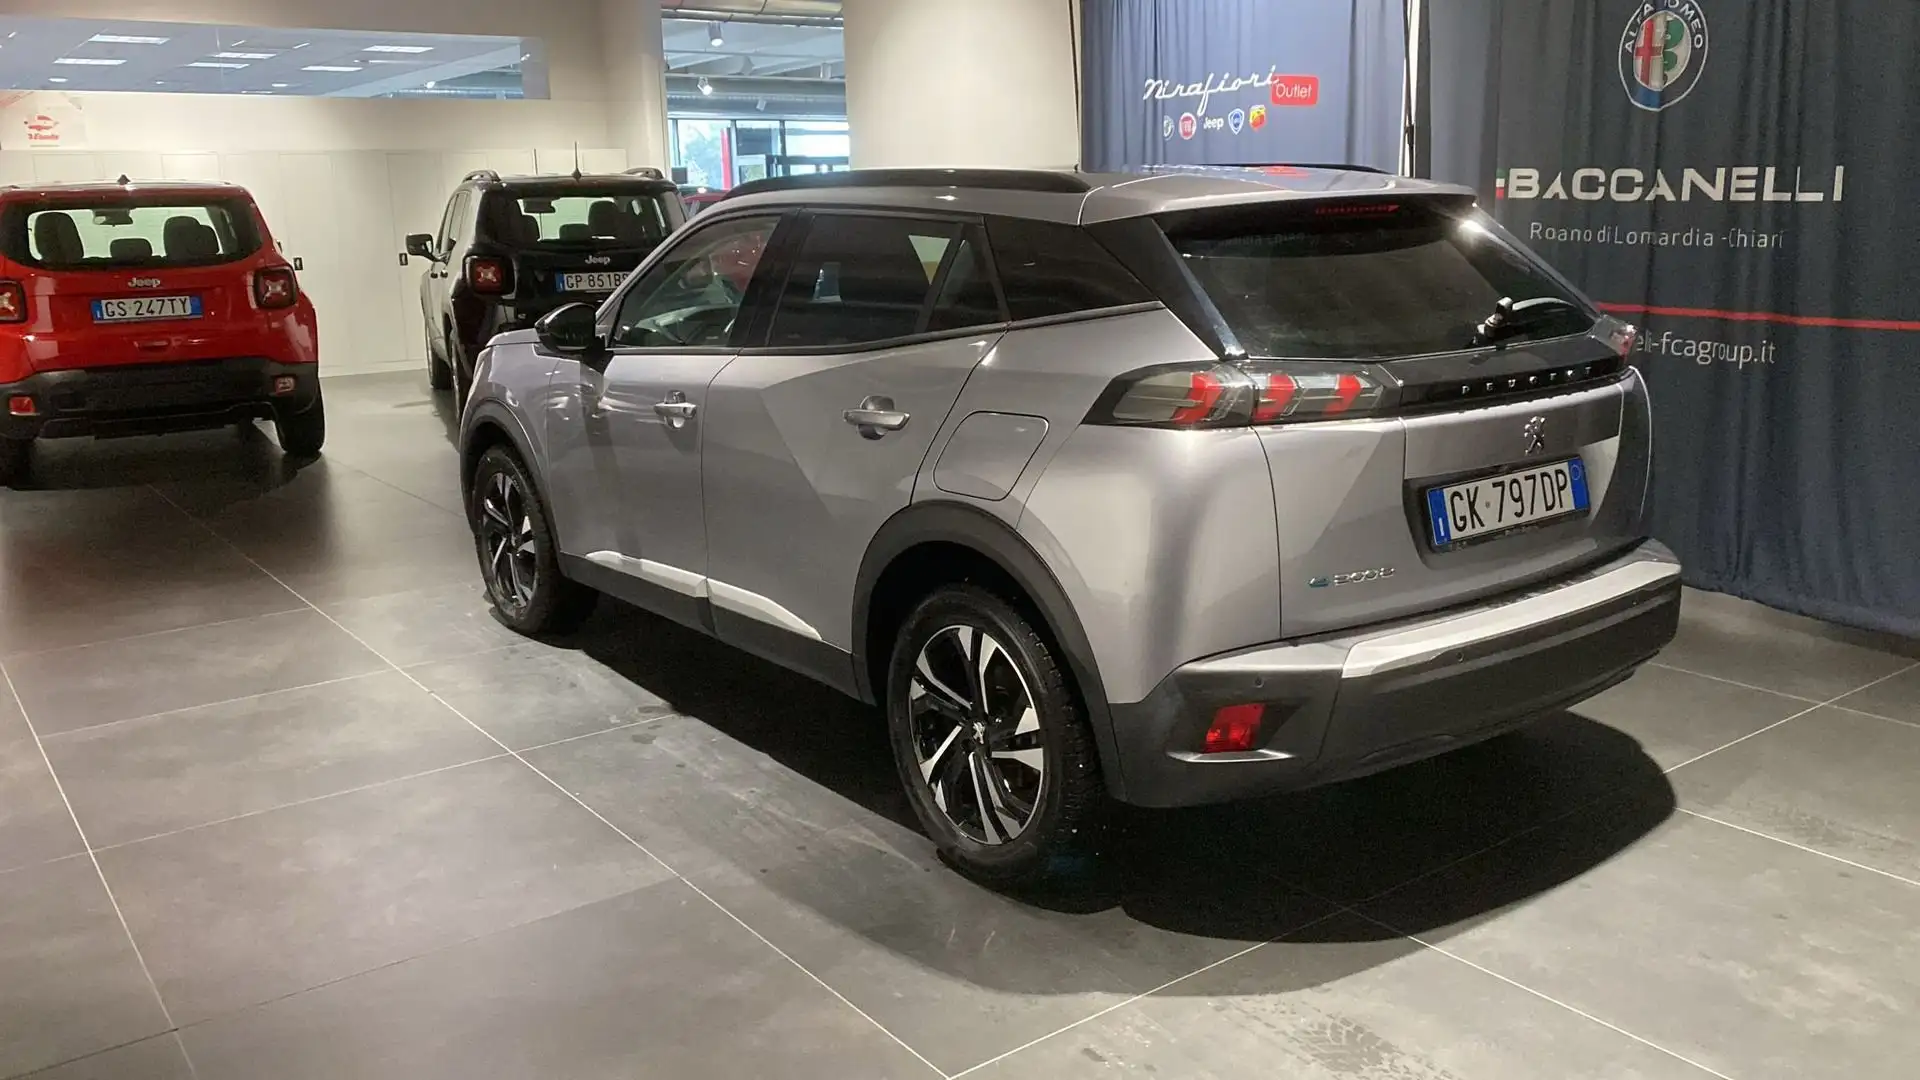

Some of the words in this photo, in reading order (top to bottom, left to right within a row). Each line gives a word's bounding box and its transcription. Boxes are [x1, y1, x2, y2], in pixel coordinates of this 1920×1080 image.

[1664, 0, 1704, 49] OMEO
[1275, 83, 1313, 99] Outlet
[1203, 116, 1225, 131] Jeep
[1508, 165, 1845, 203] BACCANELLI
[585, 254, 611, 266] Jeep
[127, 276, 161, 289] Jeep
[566, 274, 583, 289] GP
[104, 301, 127, 318] GS
[133, 297, 188, 316] 247TY
[1636, 330, 1777, 370] eli-fcagroup.it
[1449, 485, 1485, 533] GK
[1491, 468, 1568, 523] 797DP
